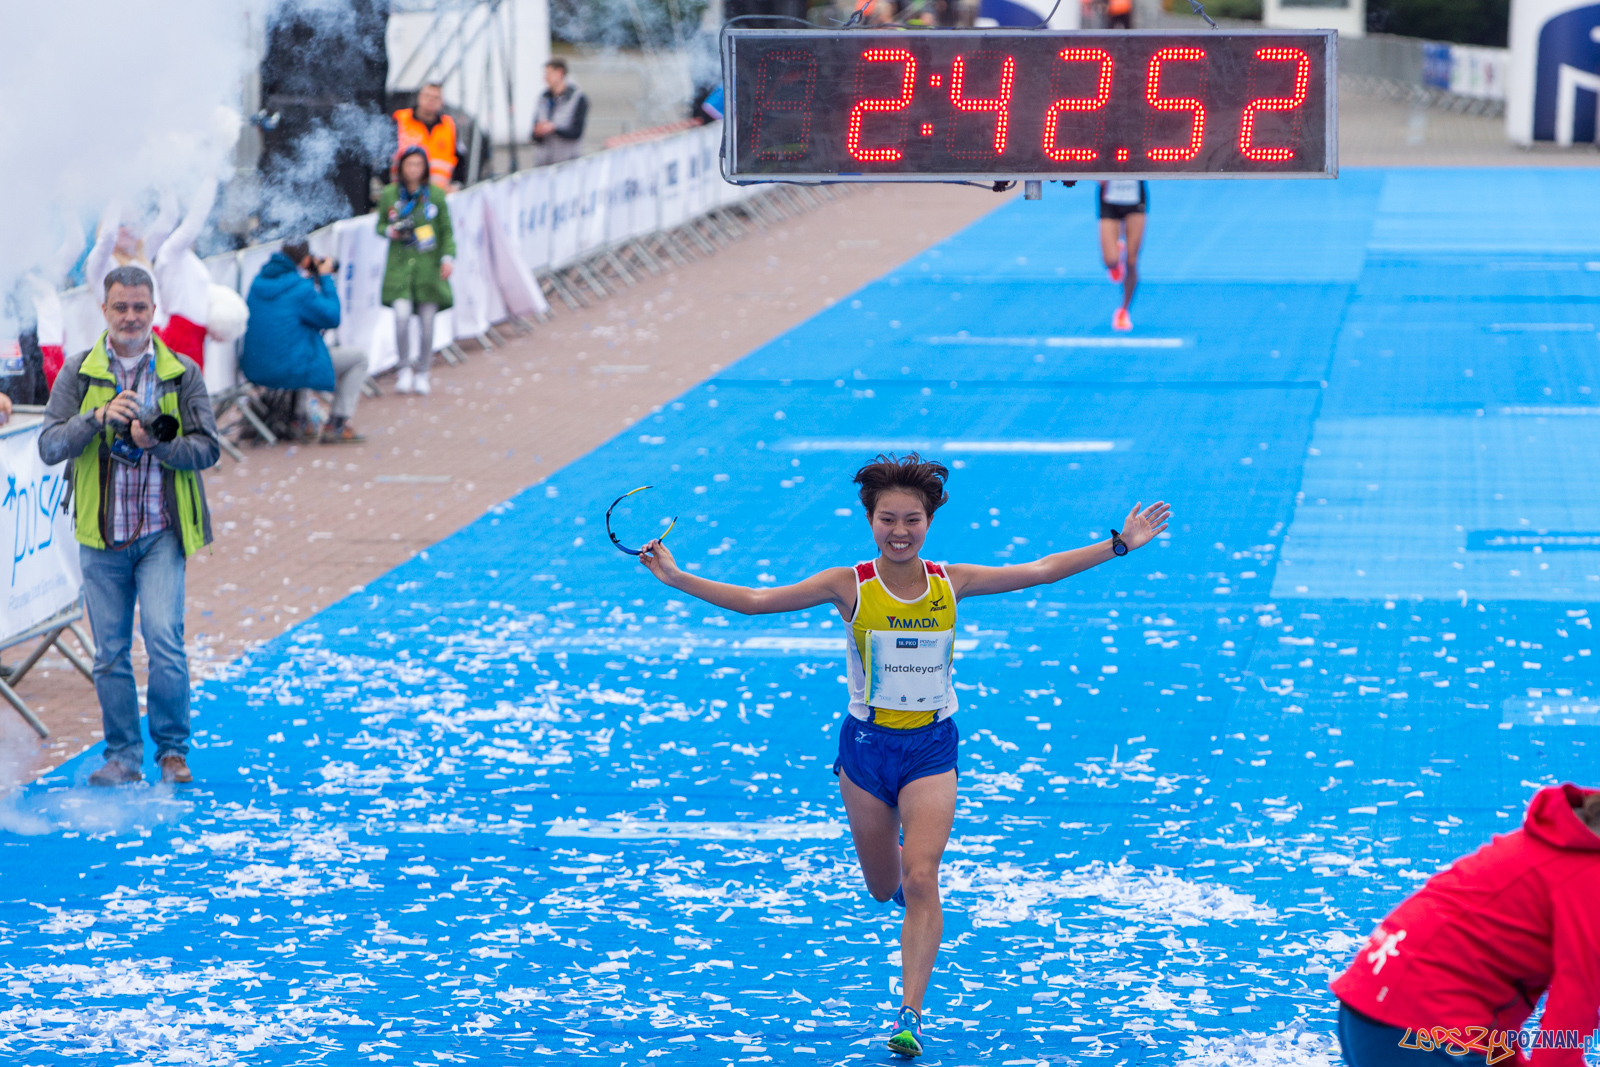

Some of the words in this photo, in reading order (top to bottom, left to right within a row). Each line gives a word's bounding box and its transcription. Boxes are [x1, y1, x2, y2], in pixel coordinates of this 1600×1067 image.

[847, 47, 1310, 163] 2:42.52
[886, 616, 939, 628] YAMADA
[884, 664, 943, 675] Hatakeyama
